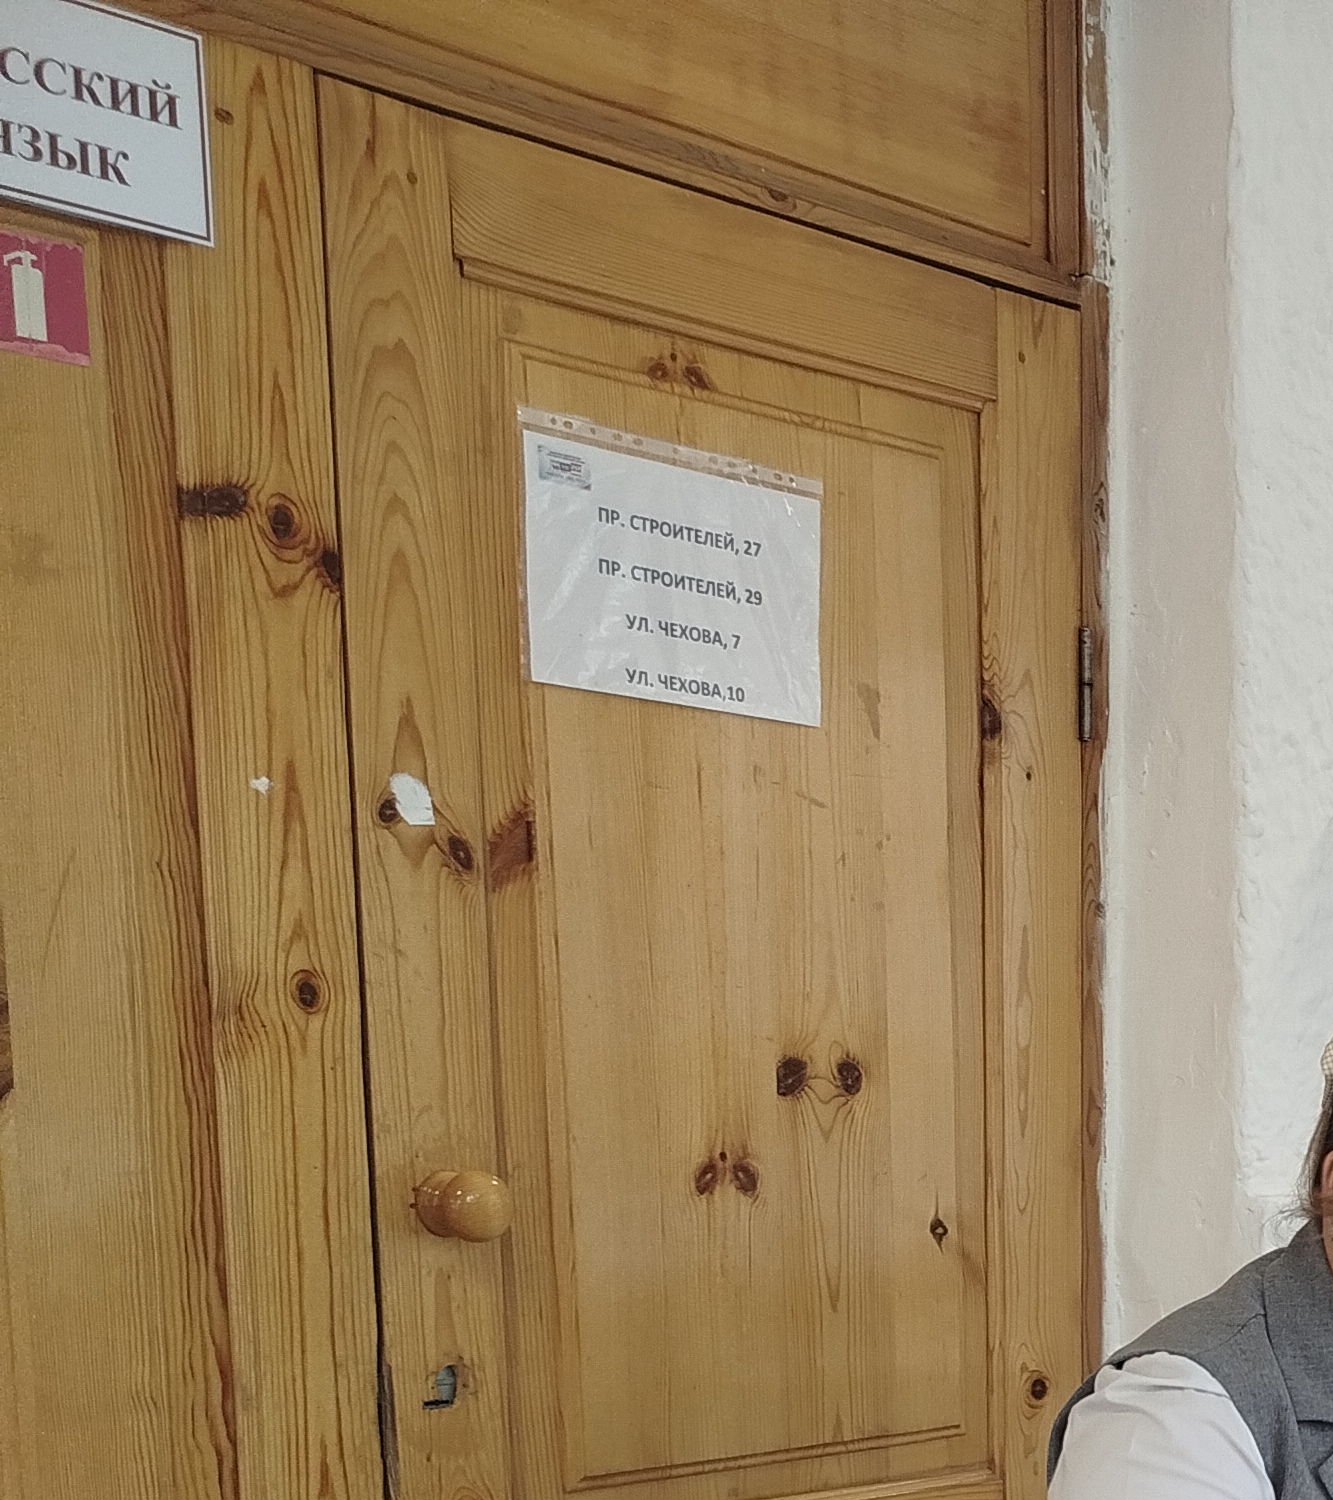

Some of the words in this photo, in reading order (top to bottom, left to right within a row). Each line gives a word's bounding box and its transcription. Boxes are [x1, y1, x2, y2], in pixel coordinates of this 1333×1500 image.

[0, 46, 182, 130] ССКИЙ
[598, 506, 626, 528] ПР.
[629, 514, 740, 556] СТРОИТЕЛЕЙ,
[743, 539, 762, 557] 27
[598, 558, 626, 578] ПР.
[630, 565, 742, 604] СТРОИТЕЛЕЙ,
[744, 588, 763, 606] 29
[625, 613, 654, 634] УЛ.
[657, 619, 728, 650] ЧЕХОВА,
[731, 634, 742, 650] 7
[625, 667, 654, 688] УЛ.
